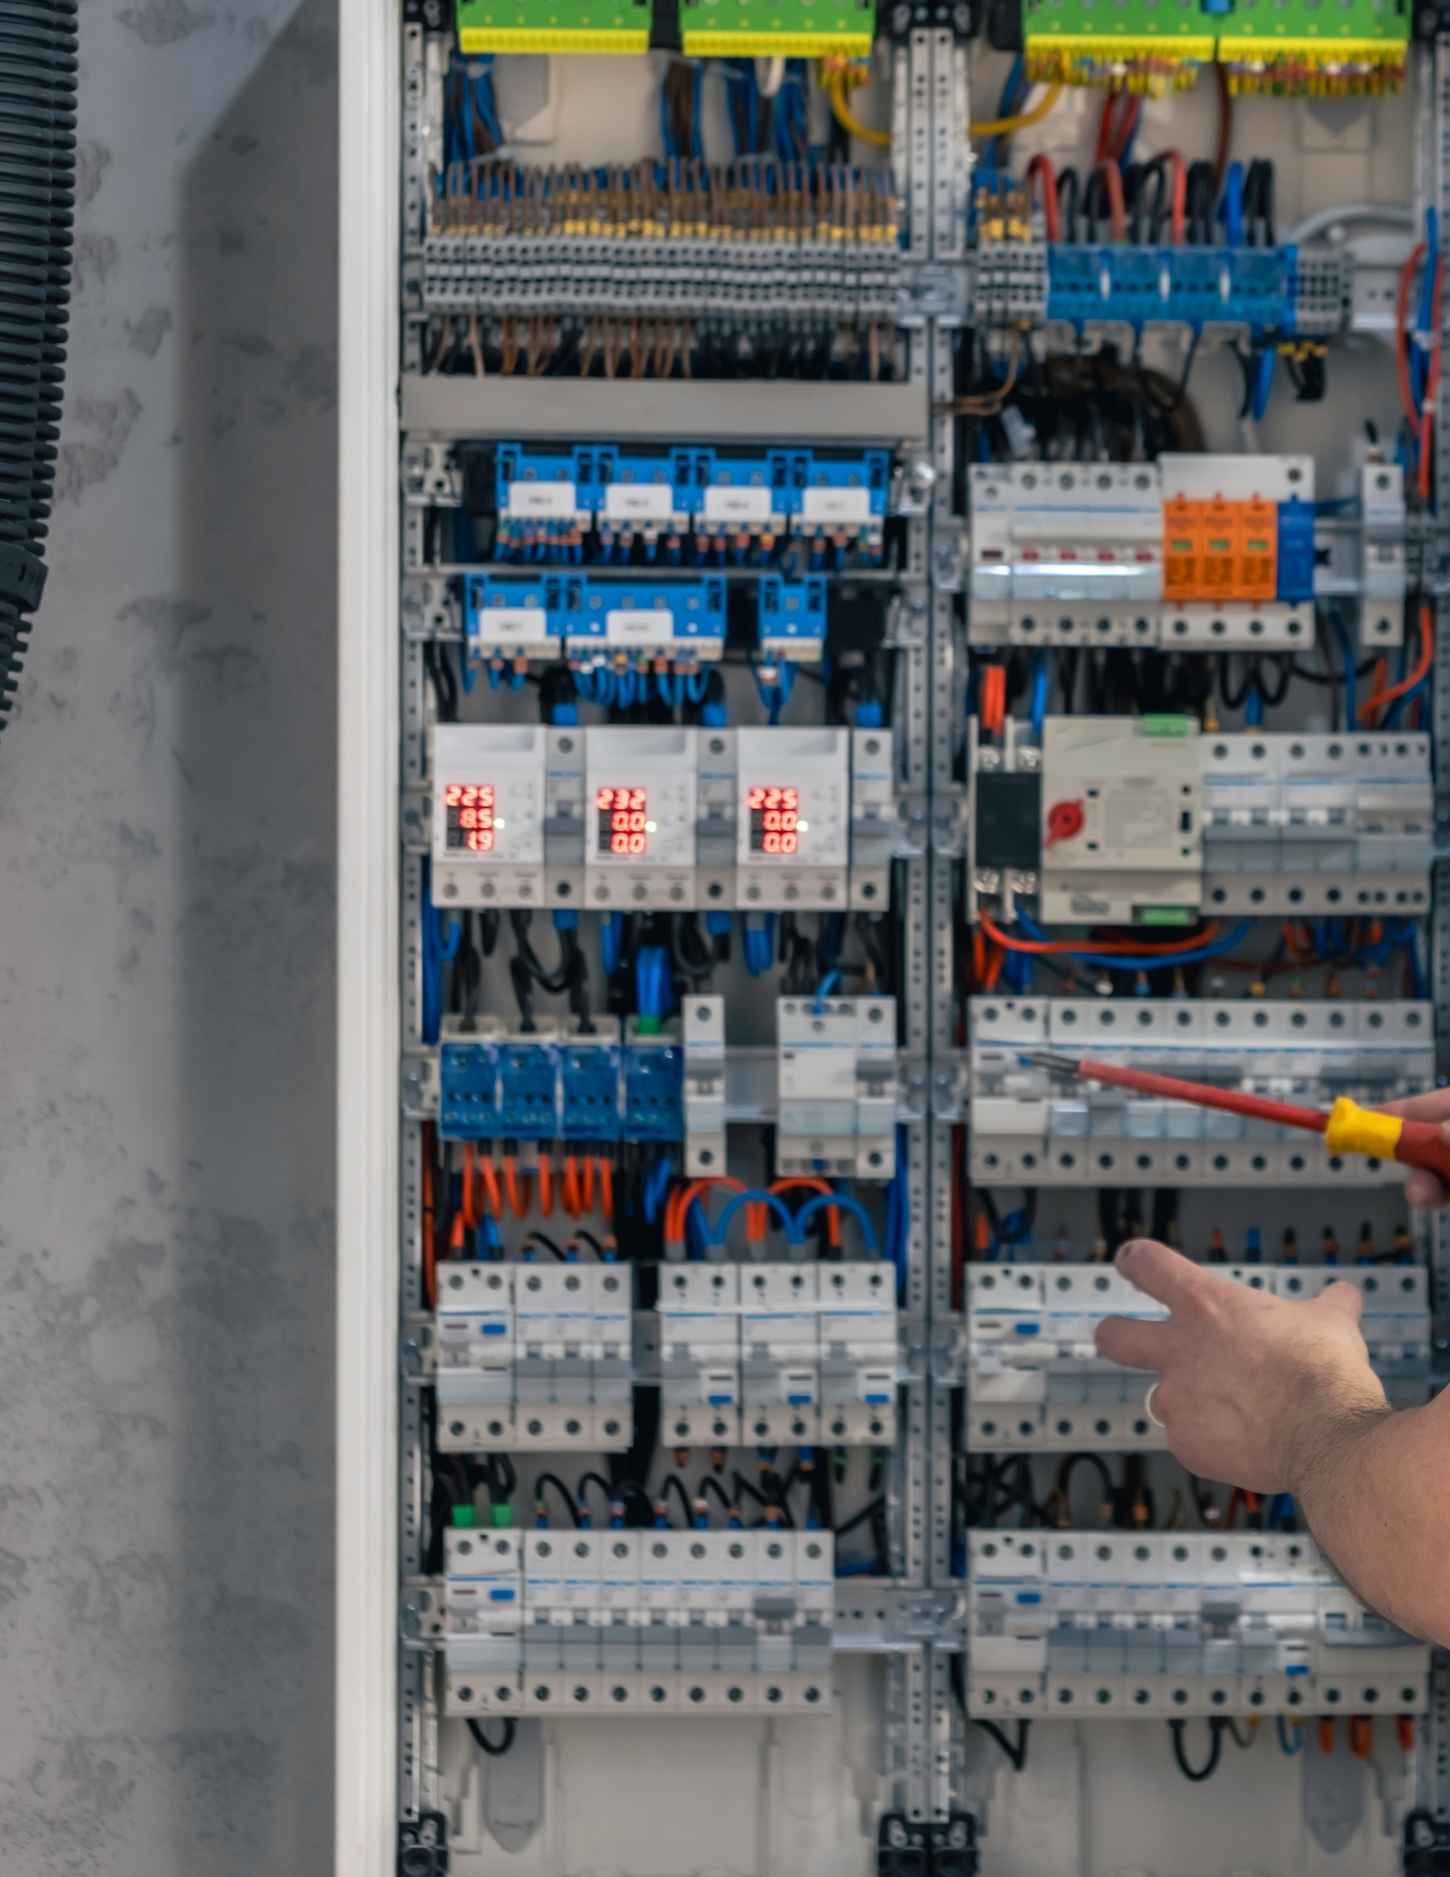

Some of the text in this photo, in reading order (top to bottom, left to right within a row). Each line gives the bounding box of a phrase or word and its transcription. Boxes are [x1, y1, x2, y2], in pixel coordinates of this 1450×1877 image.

[446, 785, 494, 807] 225
[597, 788, 646, 810] 232
[749, 787, 798, 809] 225
